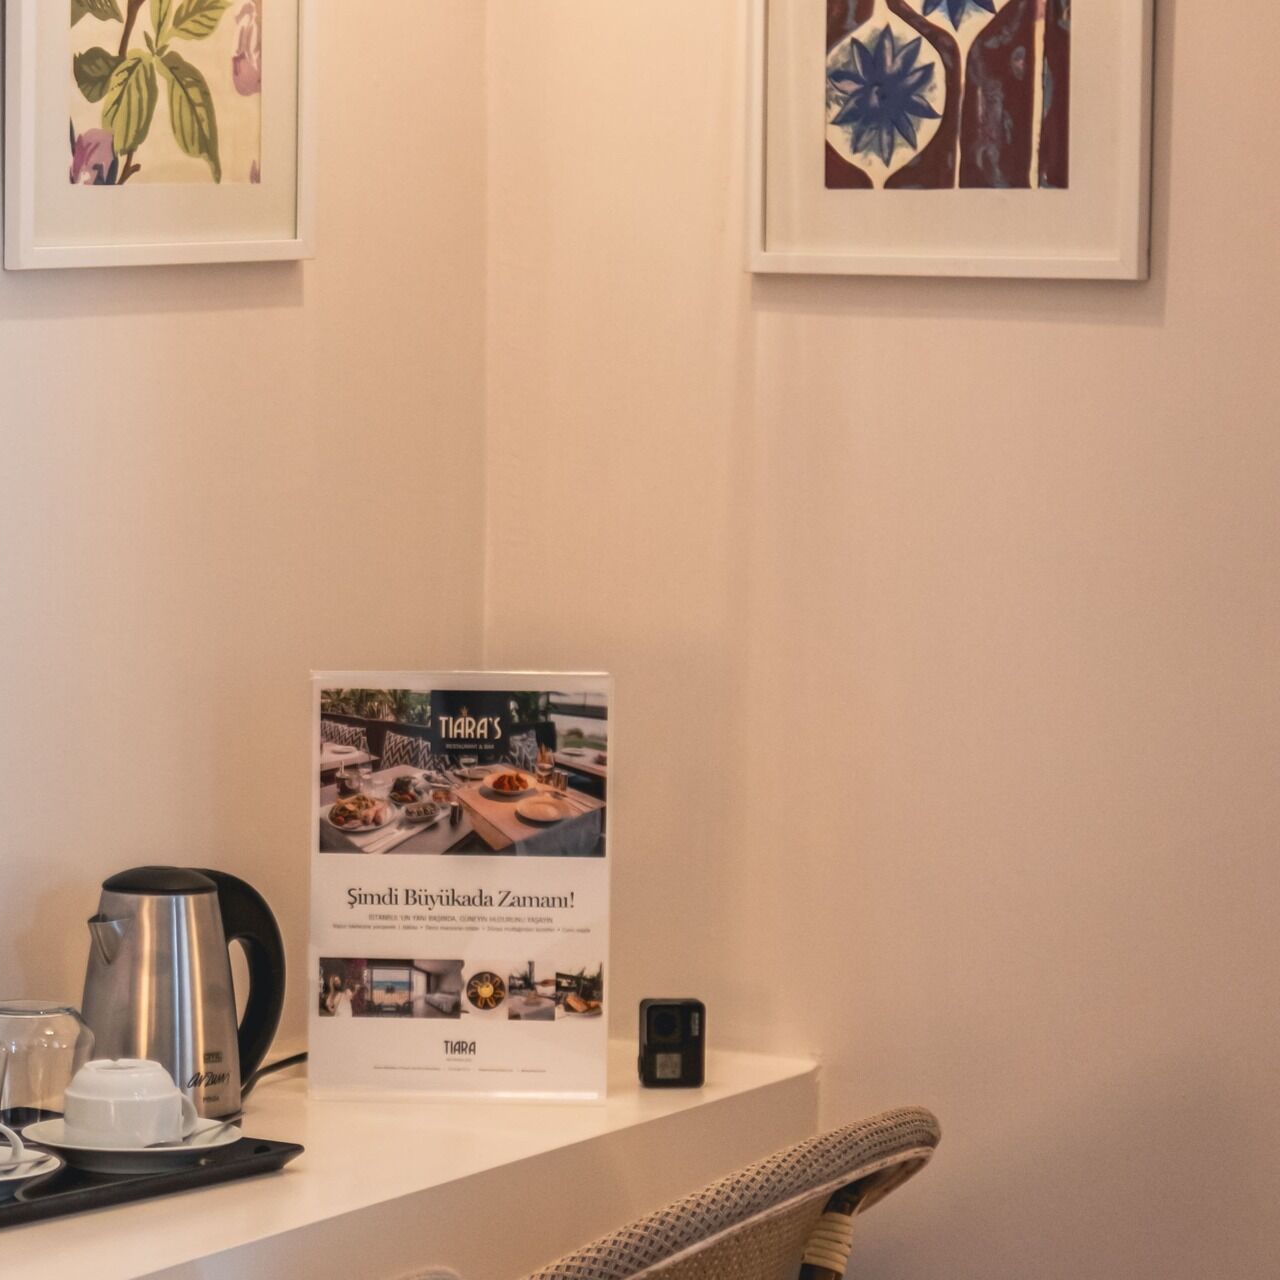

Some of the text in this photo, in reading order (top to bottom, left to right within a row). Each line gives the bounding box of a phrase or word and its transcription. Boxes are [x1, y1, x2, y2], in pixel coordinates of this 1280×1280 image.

[439, 715, 502, 740] TIARA'S
[346, 887, 575, 911] Şimdi Büyükada Zamanı!
[443, 1040, 477, 1056] TIARA
